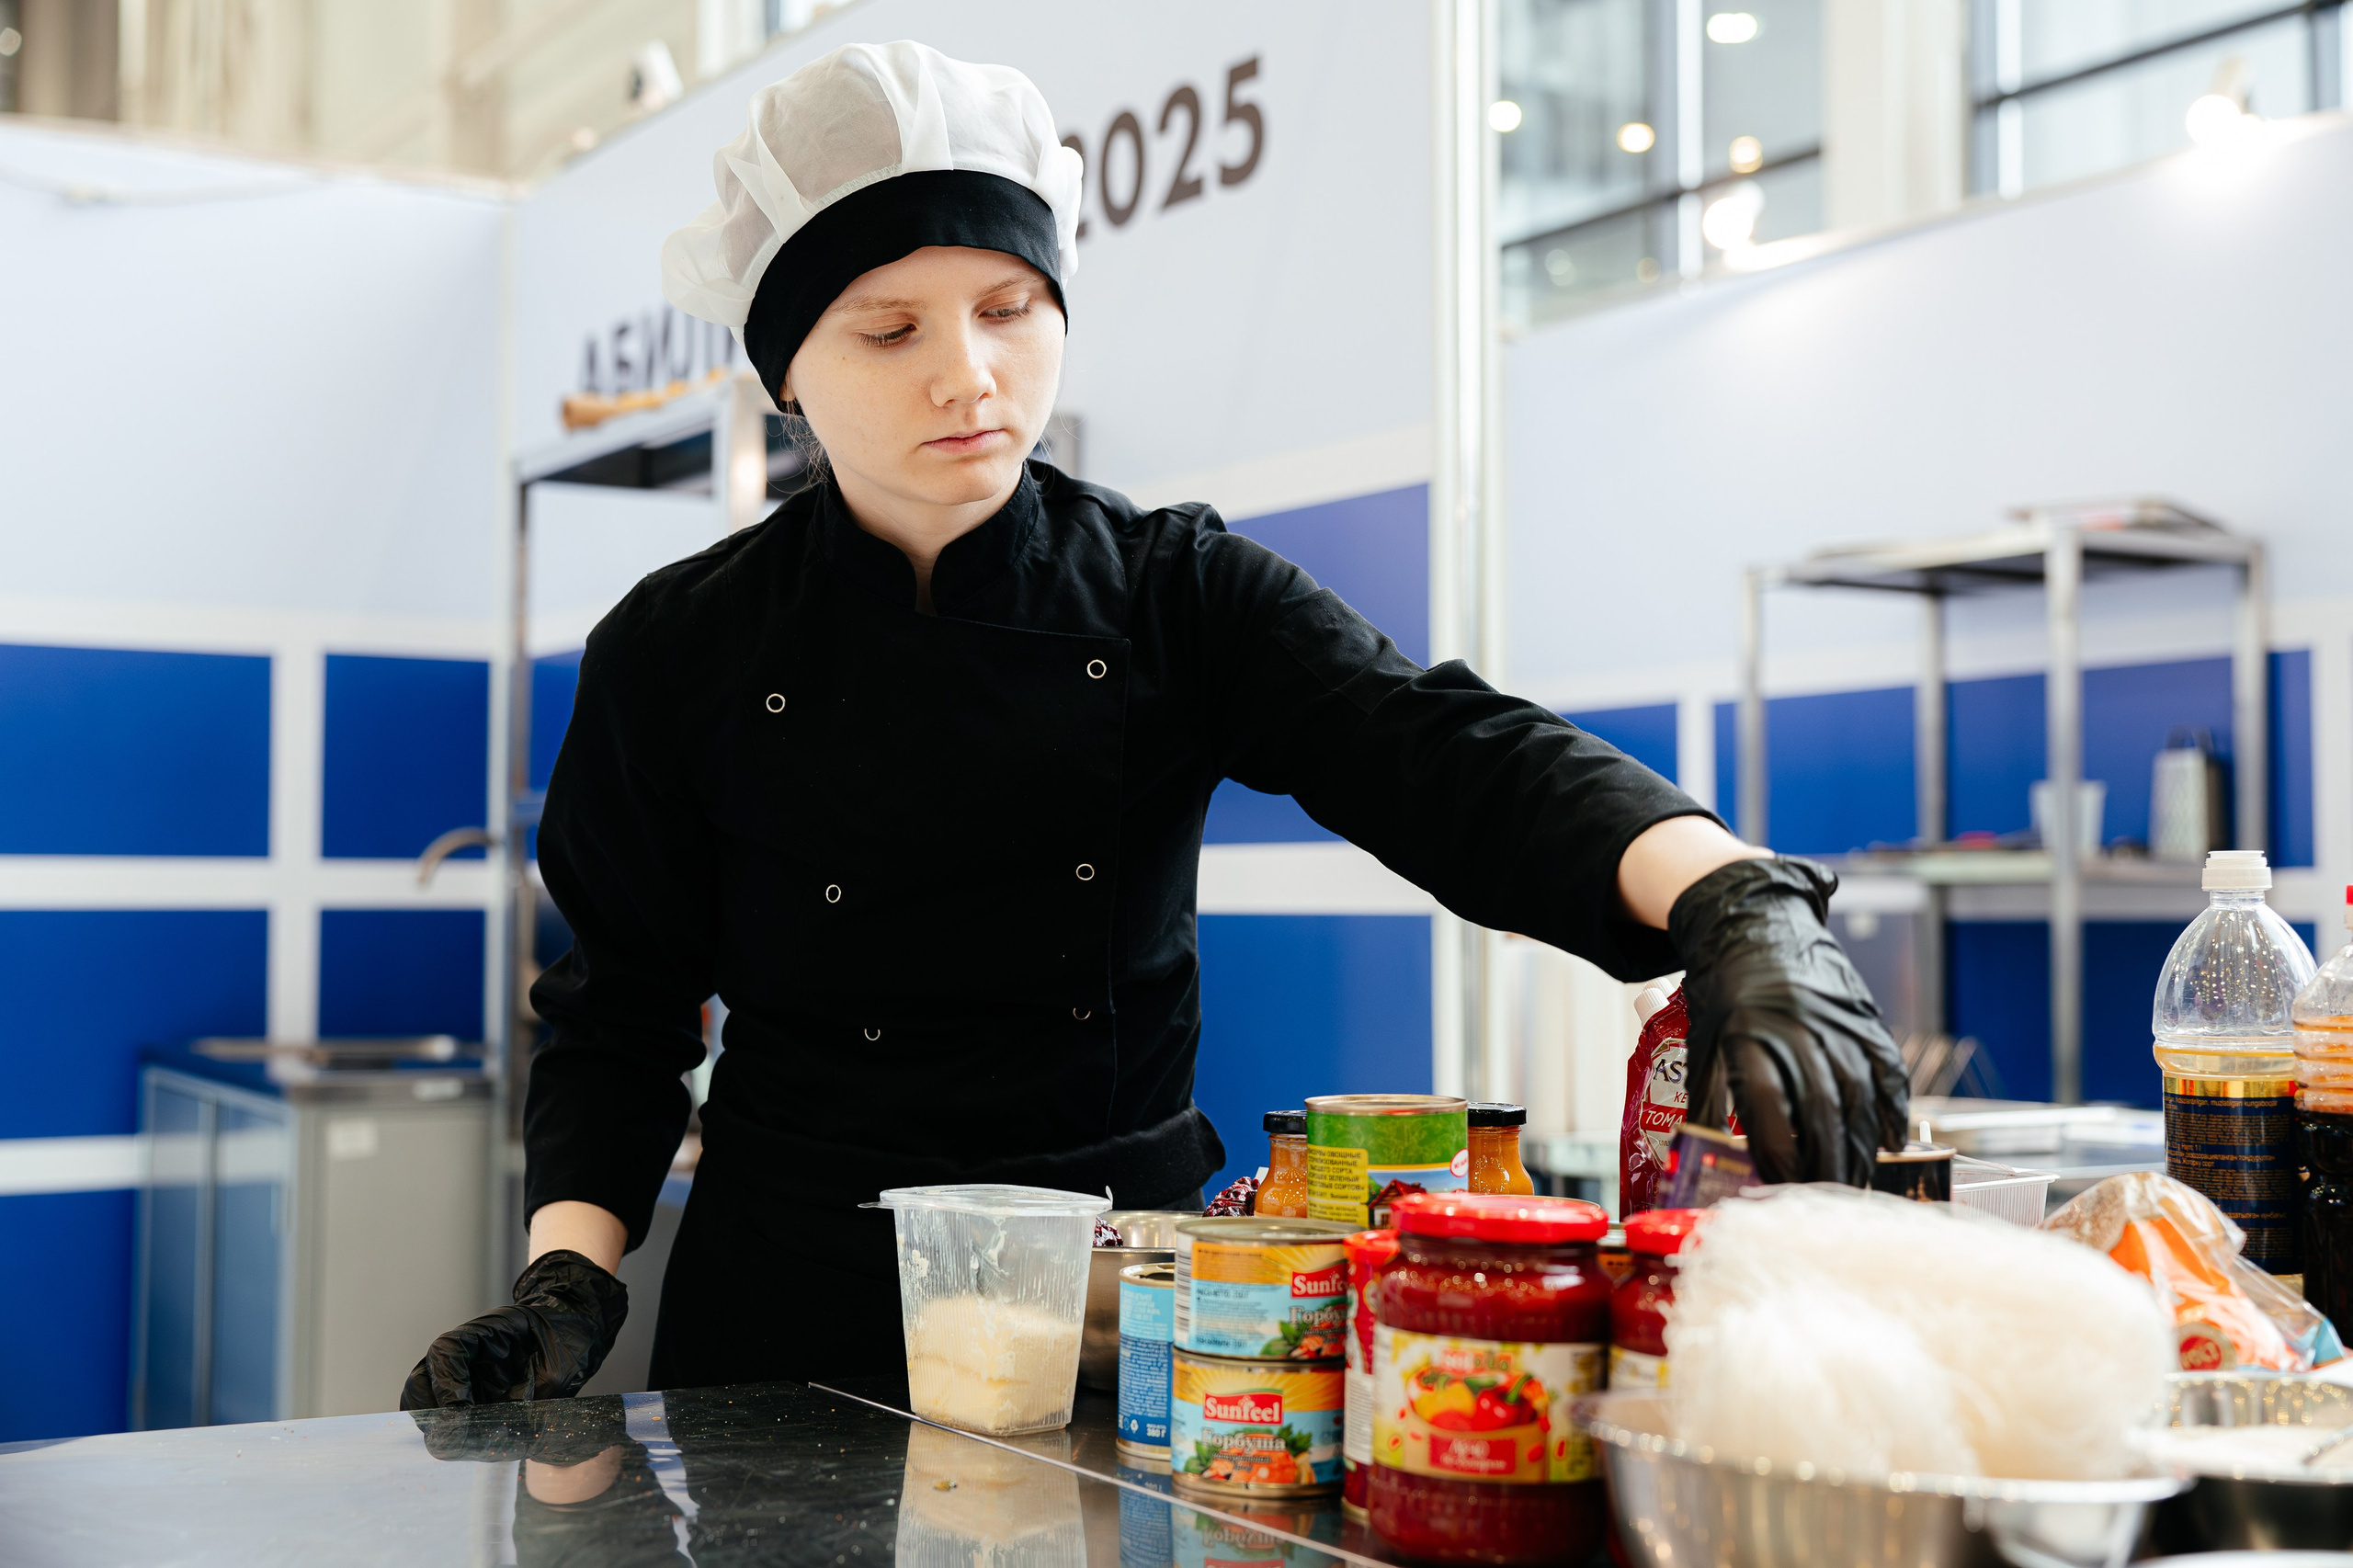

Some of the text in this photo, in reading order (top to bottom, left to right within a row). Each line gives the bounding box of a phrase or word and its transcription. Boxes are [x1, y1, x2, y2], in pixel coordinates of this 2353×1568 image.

[1061, 53, 1266, 241] 025
[1653, 1058, 1688, 1084] AS
[1205, 1395, 1280, 1423] Sunfeel
[1201, 1427, 1286, 1452] Горбуша
